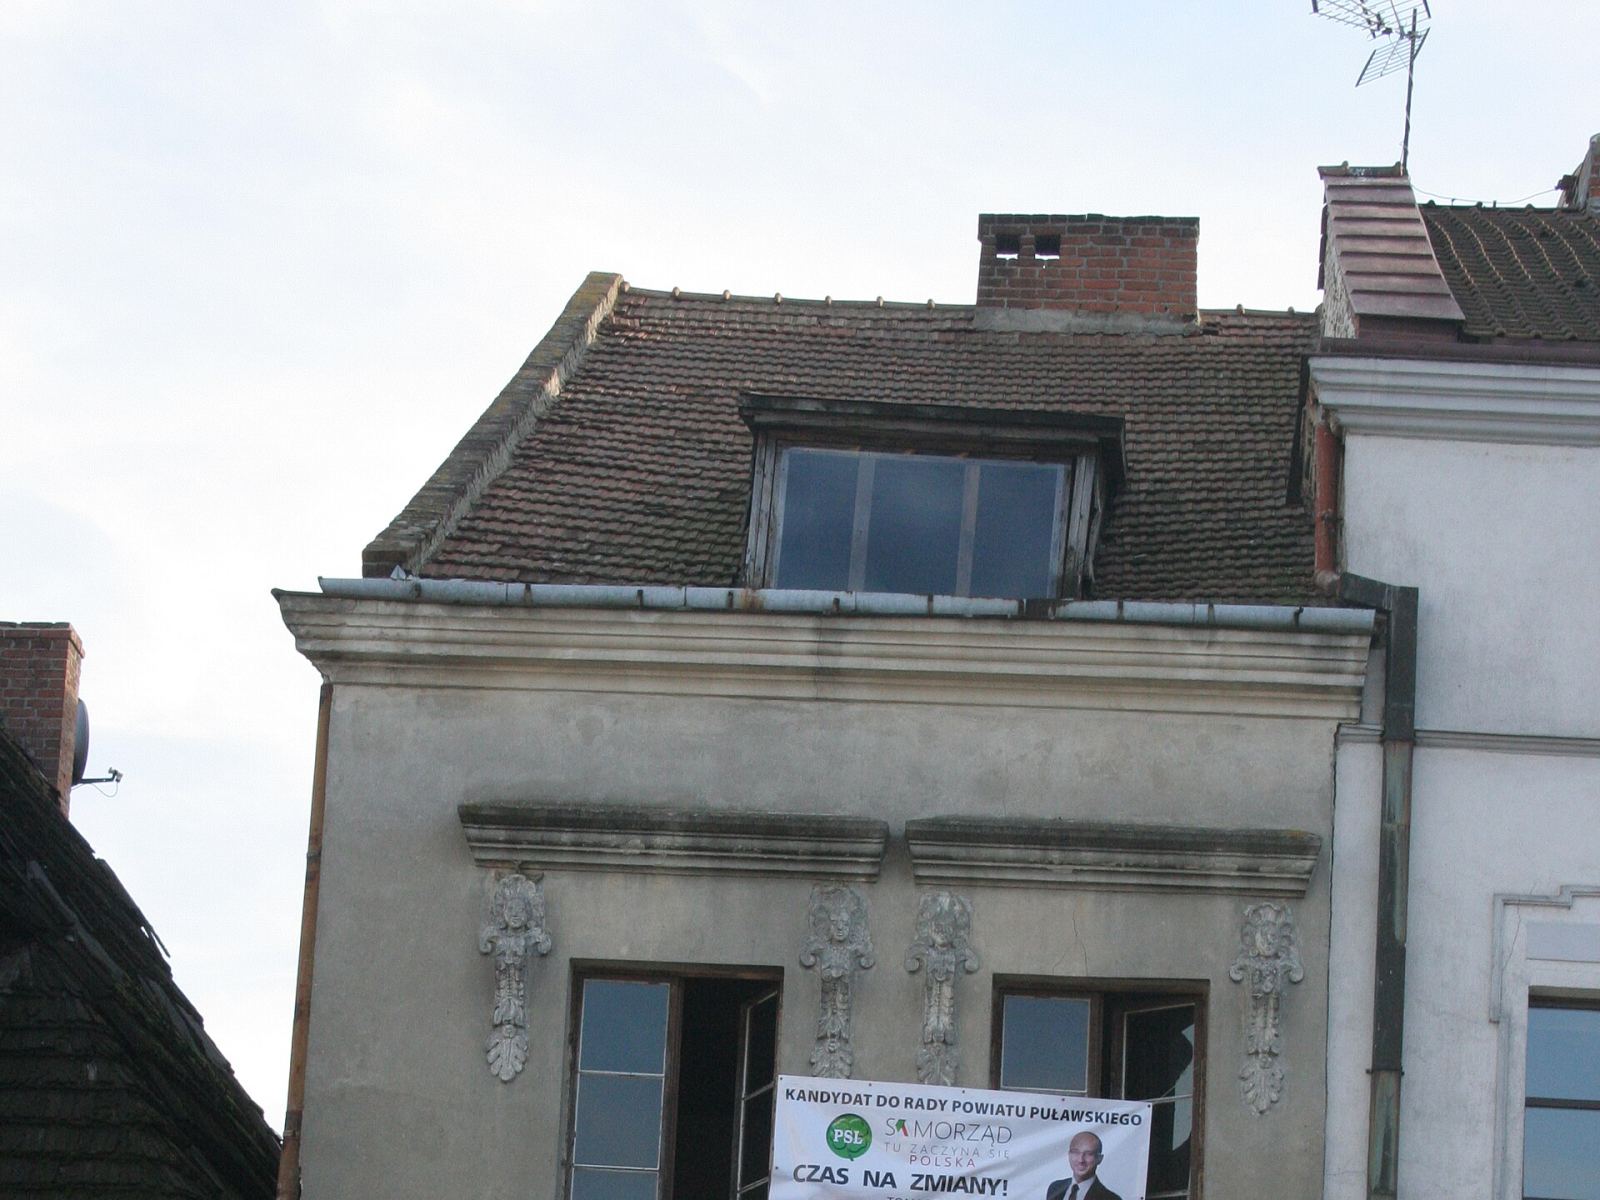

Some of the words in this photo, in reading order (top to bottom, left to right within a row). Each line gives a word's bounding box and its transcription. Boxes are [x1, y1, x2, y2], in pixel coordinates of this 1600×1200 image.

[785, 1088, 872, 1106] KANDYDAT
[876, 1095, 900, 1108] DO
[904, 1097, 948, 1112] RADY
[952, 1101, 1026, 1118] POWIATU
[1030, 1107, 1142, 1126] PUŁAWSKIEGO
[885, 1118, 1012, 1147] SAMORZĄD
[884, 1142, 901, 1153] TU
[910, 1143, 979, 1157] ZACZYNA
[909, 1155, 975, 1168] POLSKA
[793, 1164, 849, 1185] CZAS
[863, 1170, 897, 1188] NA
[910, 1173, 1008, 1196] ZMIANY!
